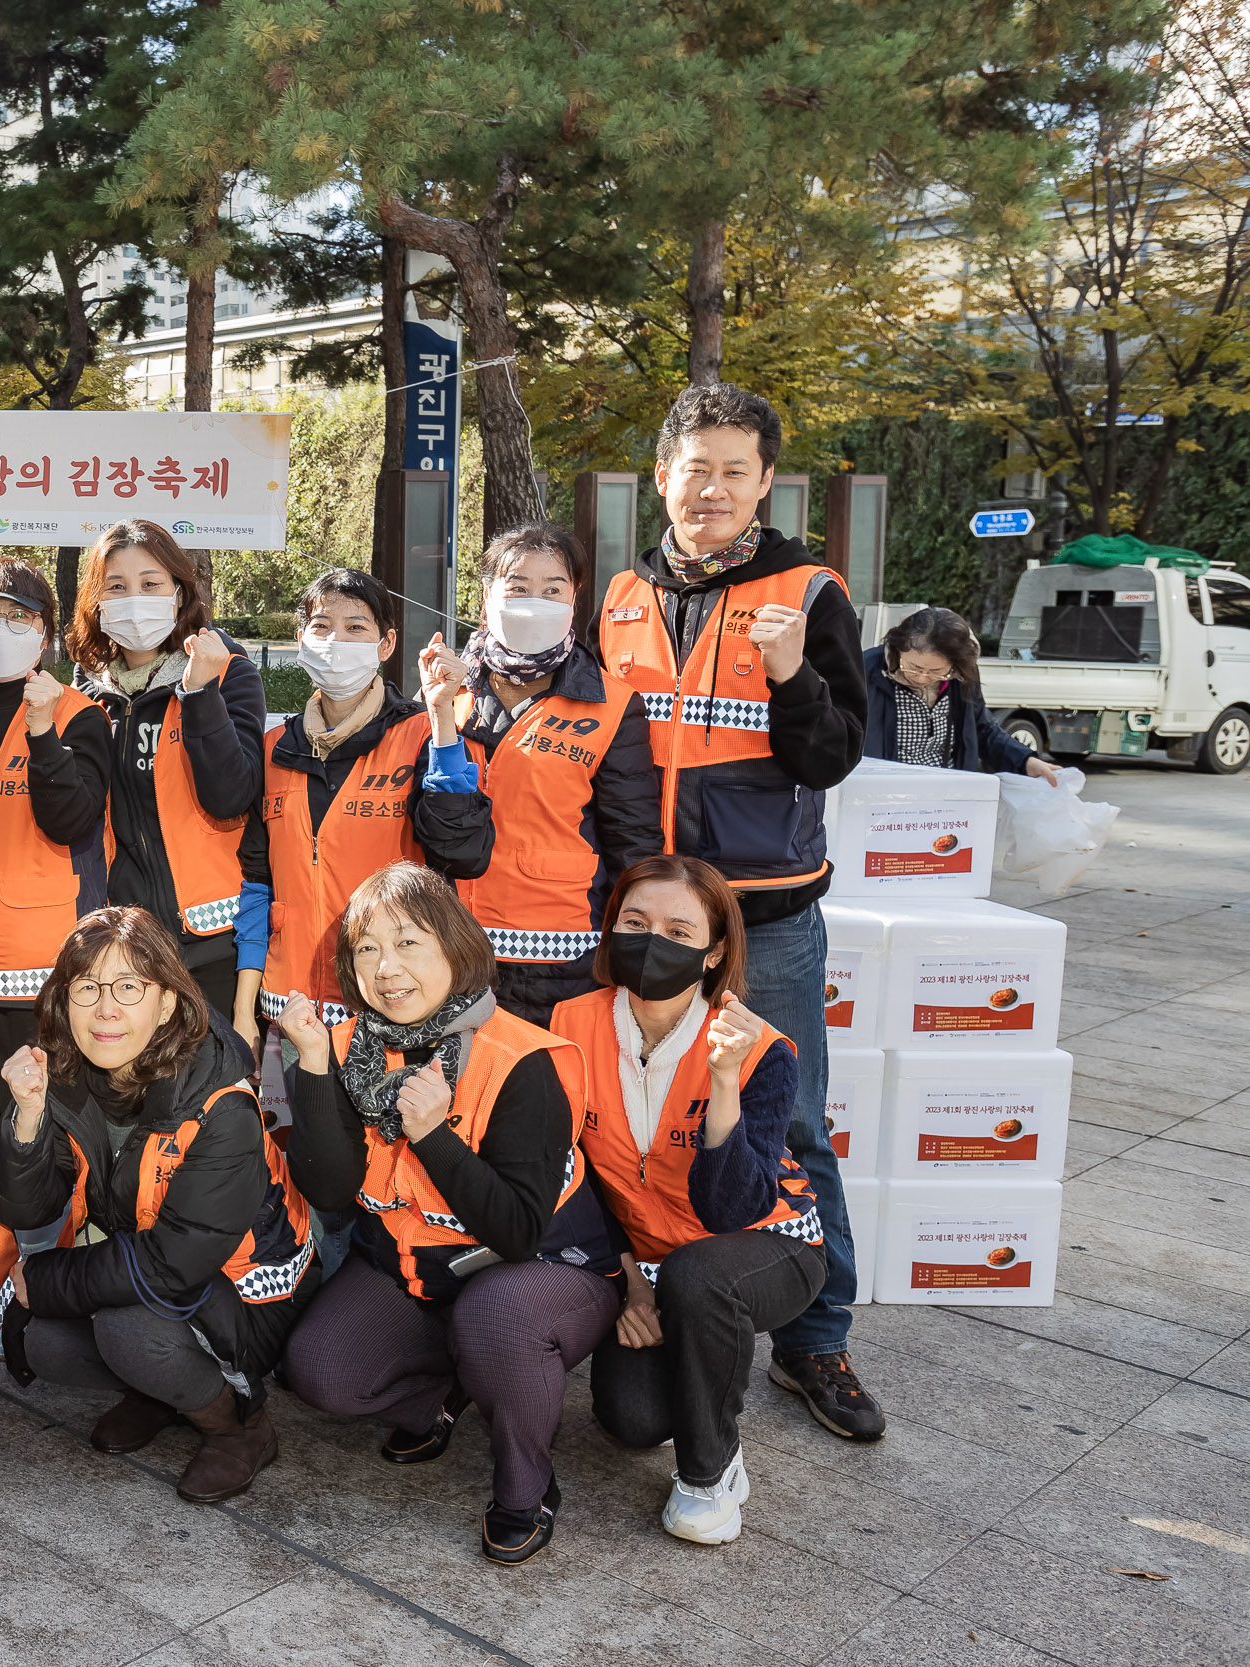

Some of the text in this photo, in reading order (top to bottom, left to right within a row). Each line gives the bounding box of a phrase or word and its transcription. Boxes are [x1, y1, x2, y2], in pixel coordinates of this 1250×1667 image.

[67, 455, 230, 500] 김장축제
[541, 714, 601, 738] 119
[521, 733, 597, 769] 의용소방대
[359, 764, 415, 792] 119
[343, 800, 408, 818] 의용소방
[870, 823, 886, 832] 2023
[905, 822, 918, 832] 광진
[920, 821, 940, 831] 사랑의
[942, 820, 969, 830] 김장축제
[919, 975, 936, 984] 2023
[958, 975, 974, 984] 광진
[975, 974, 998, 984] 사랑의
[1000, 974, 1030, 983] 김장축제
[925, 1105, 941, 1114] 2023
[963, 1105, 979, 1115] 광진
[980, 1105, 1003, 1115] 사랑의
[1004, 1105, 1035, 1114] 김장축제
[917, 1234, 934, 1242] 2023
[956, 1233, 971, 1243] 광진
[973, 1233, 996, 1243] 사랑의
[998, 1232, 1028, 1242] 김장축제
